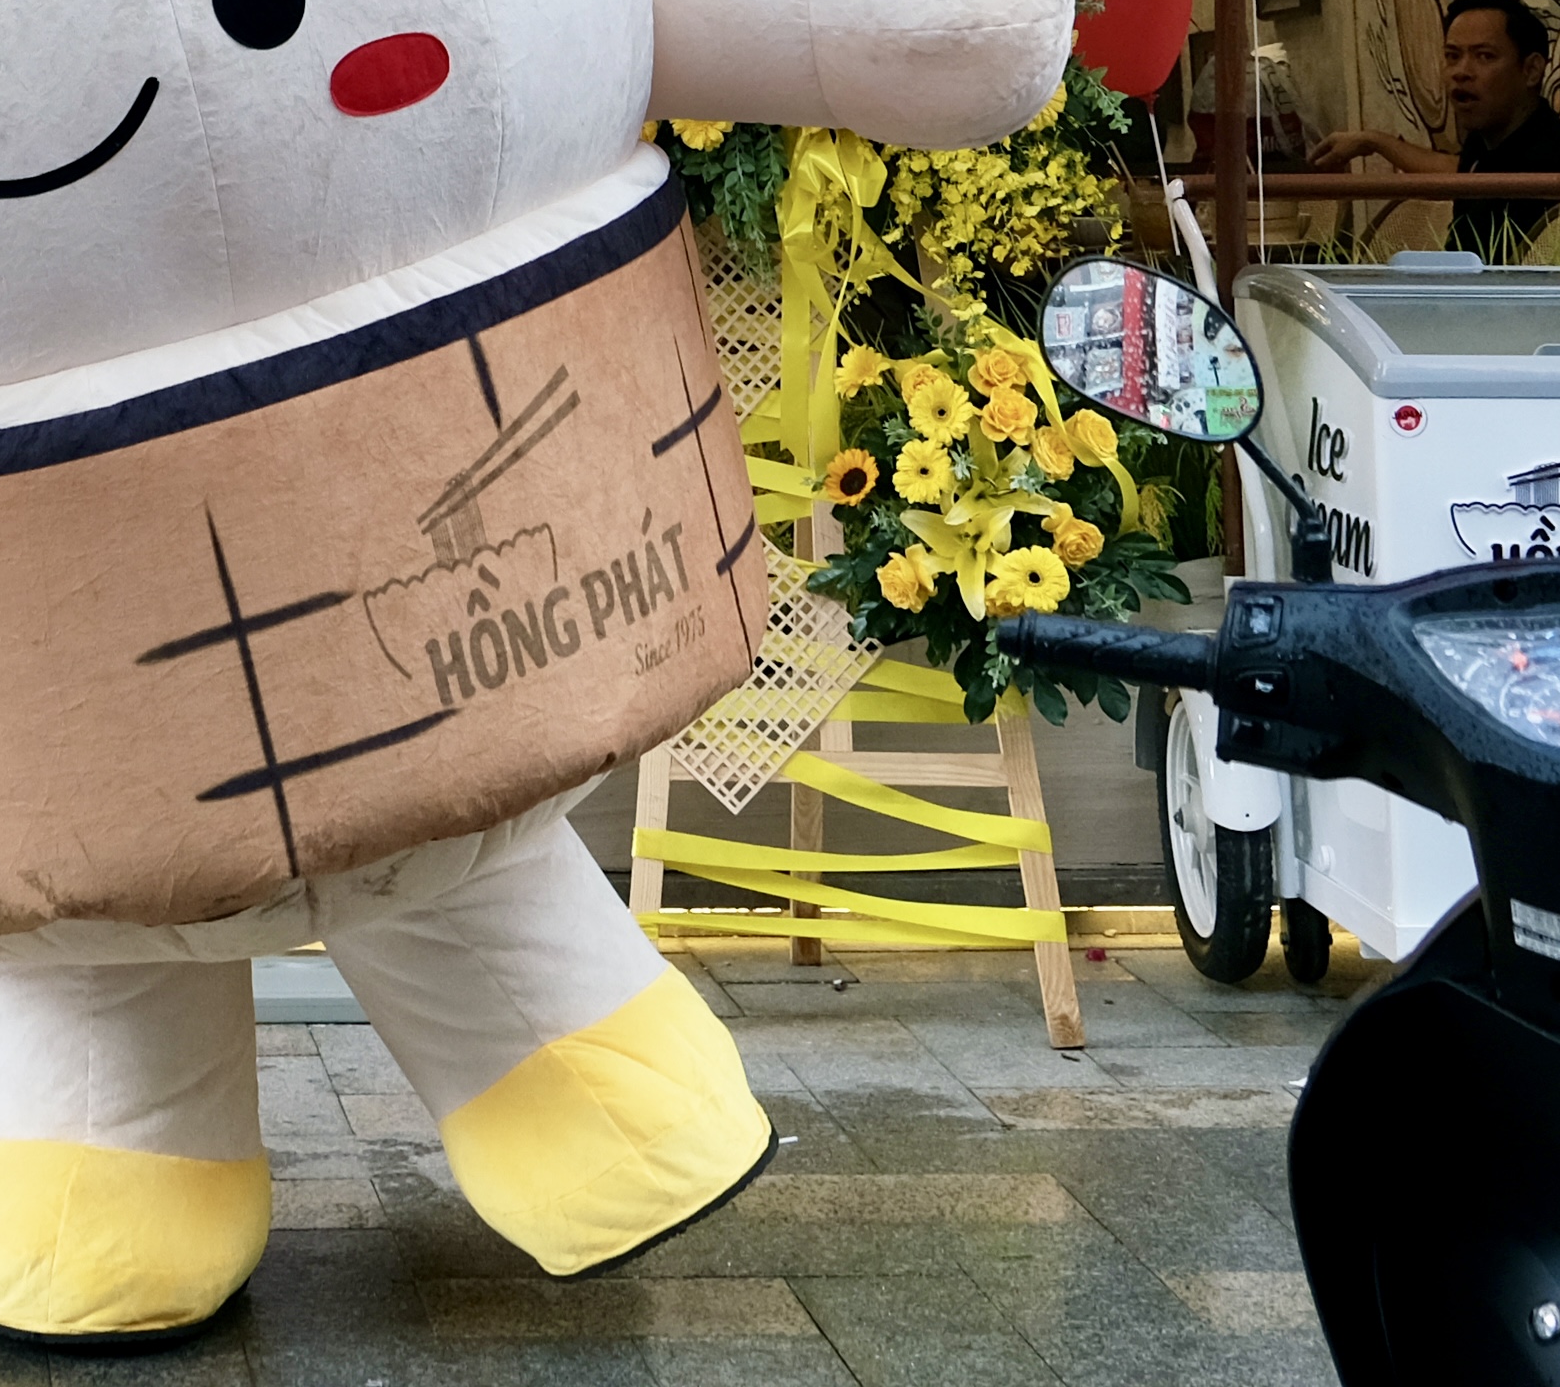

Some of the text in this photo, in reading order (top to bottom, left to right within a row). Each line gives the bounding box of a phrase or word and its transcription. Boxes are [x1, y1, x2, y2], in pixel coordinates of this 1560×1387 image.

[1307, 396, 1346, 482] Ice
[425, 506, 691, 706] HỒNG PHÁT
[634, 604, 706, 676] Since 1975
